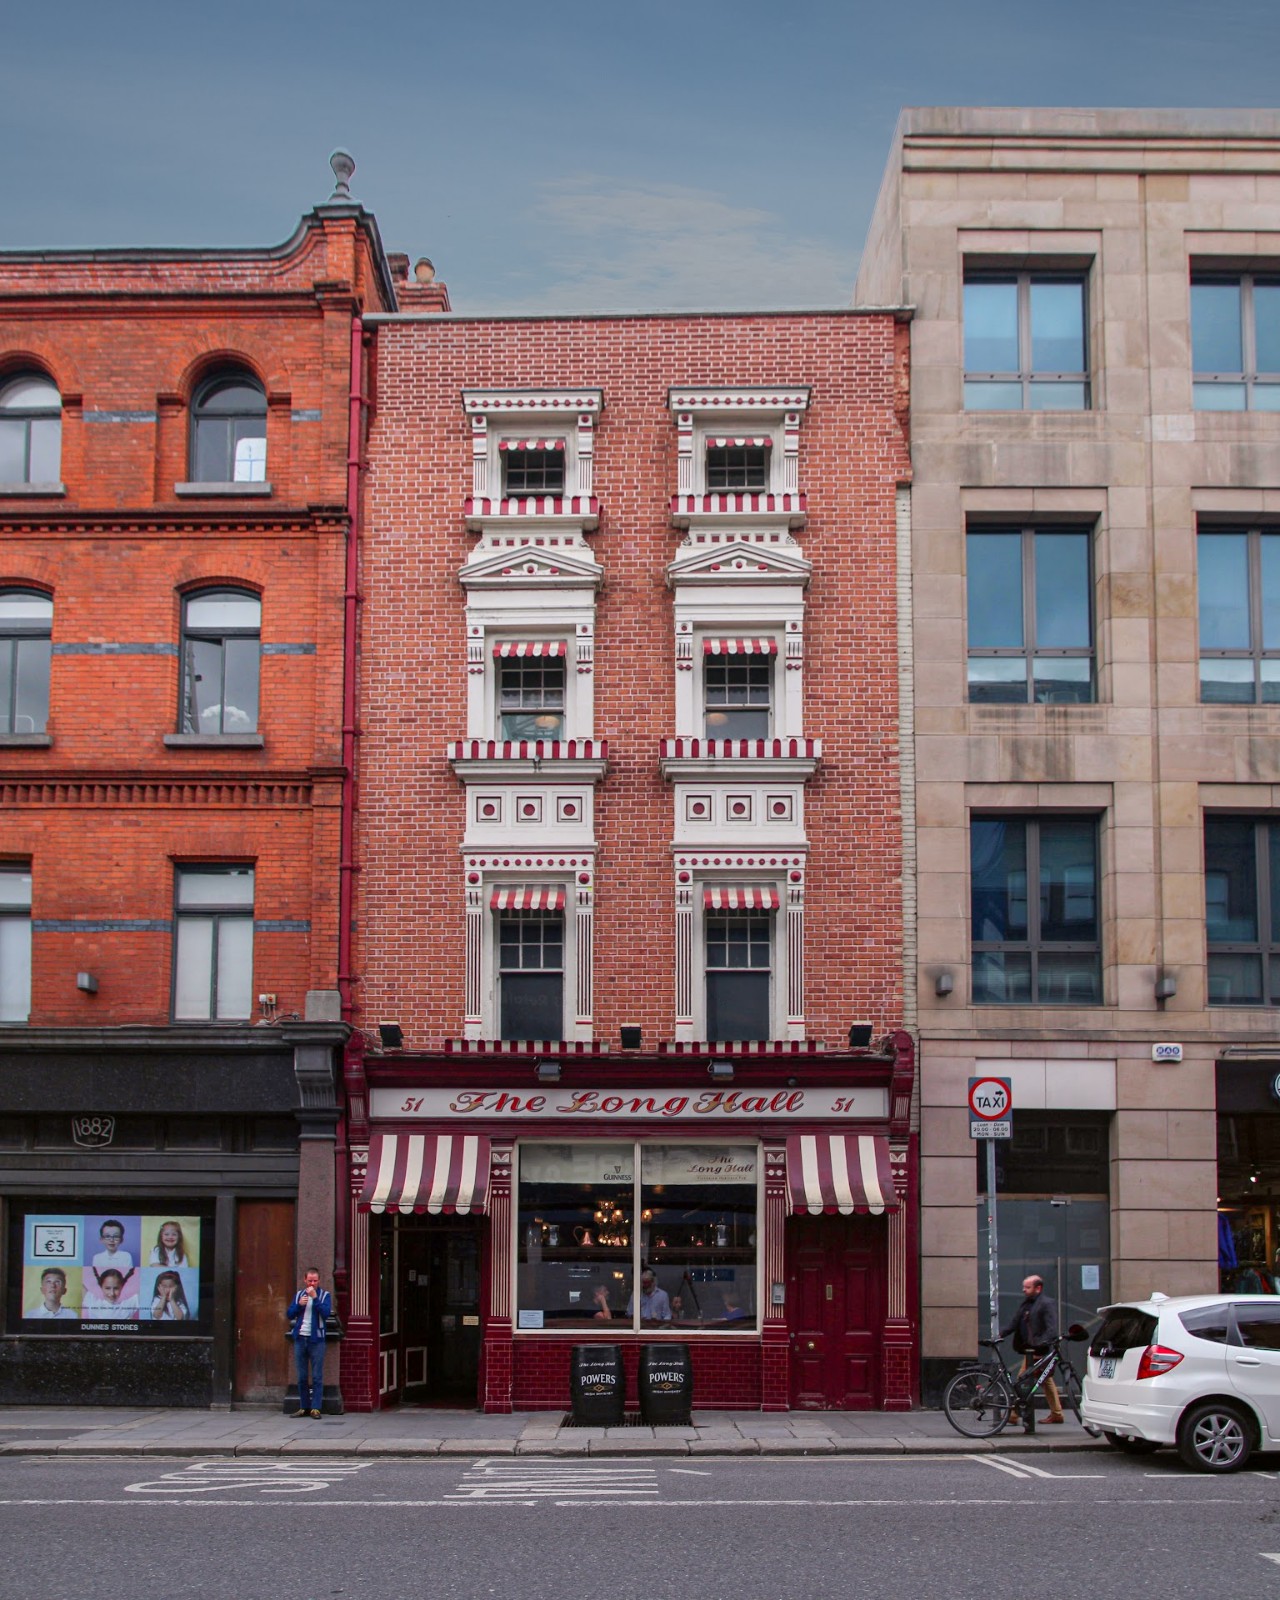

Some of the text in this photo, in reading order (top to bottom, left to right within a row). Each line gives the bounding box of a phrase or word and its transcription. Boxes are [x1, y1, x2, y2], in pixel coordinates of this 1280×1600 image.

[401, 1090, 855, 1116] 51 The Long Hall 51
[976, 1097, 1004, 1108] TAXI
[75, 1117, 112, 1137] 1882
[708, 1155, 735, 1164] The
[687, 1163, 754, 1174] Long Hall
[603, 1173, 632, 1181] GUINNESS
[44, 1240, 65, 1252] €3
[581, 1374, 616, 1385] POWERS
[649, 1372, 685, 1384] POWERS
